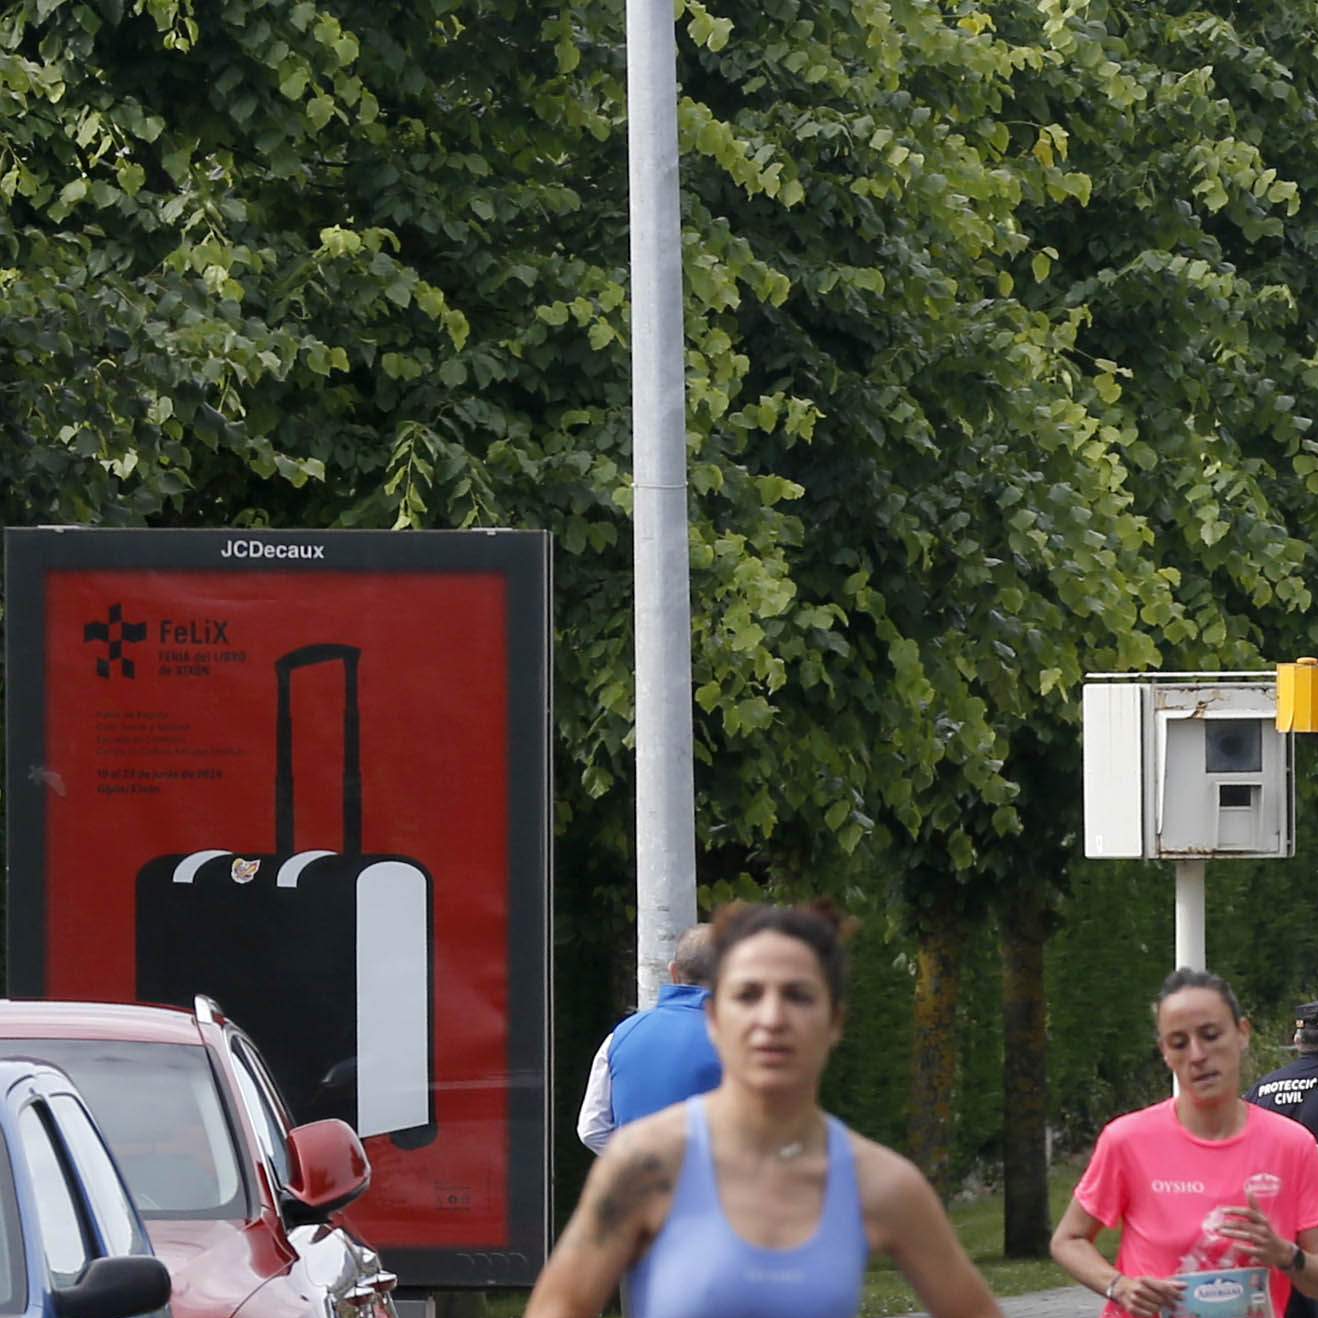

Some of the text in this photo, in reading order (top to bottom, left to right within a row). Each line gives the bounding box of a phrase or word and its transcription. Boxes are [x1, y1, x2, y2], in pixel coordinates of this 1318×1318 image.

[221, 540, 324, 559] JCDecaux
[160, 619, 229, 644] FeLiX
[1274, 1091, 1304, 1105] CIVIL
[1151, 1179, 1205, 1193] OYSHO
